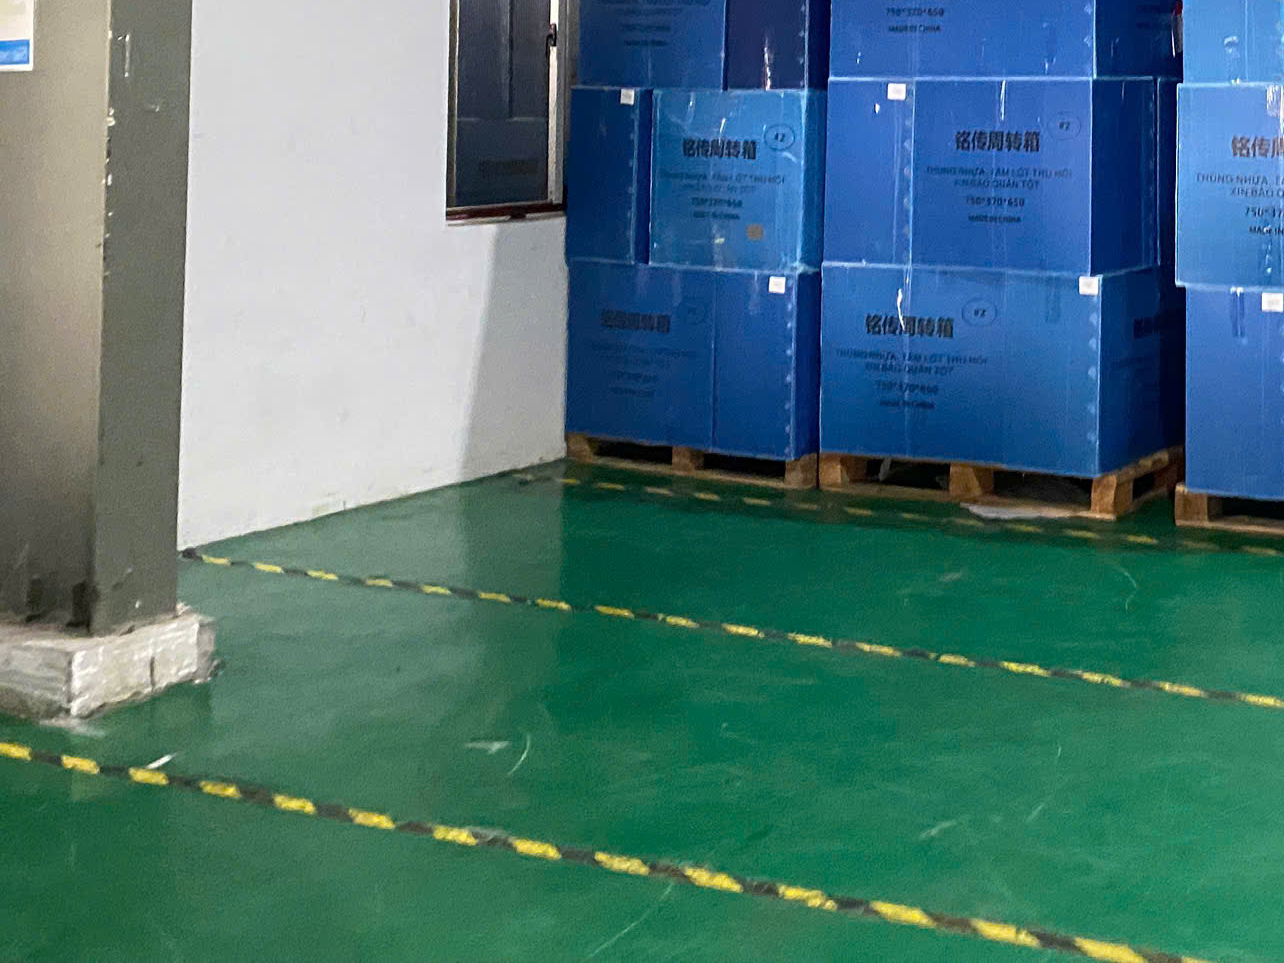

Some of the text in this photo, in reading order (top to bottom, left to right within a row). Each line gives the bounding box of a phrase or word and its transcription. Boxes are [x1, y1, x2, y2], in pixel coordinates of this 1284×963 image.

[955, 129, 1041, 153] 铭传周转箱
[865, 312, 954, 339] 铭传周转箱
